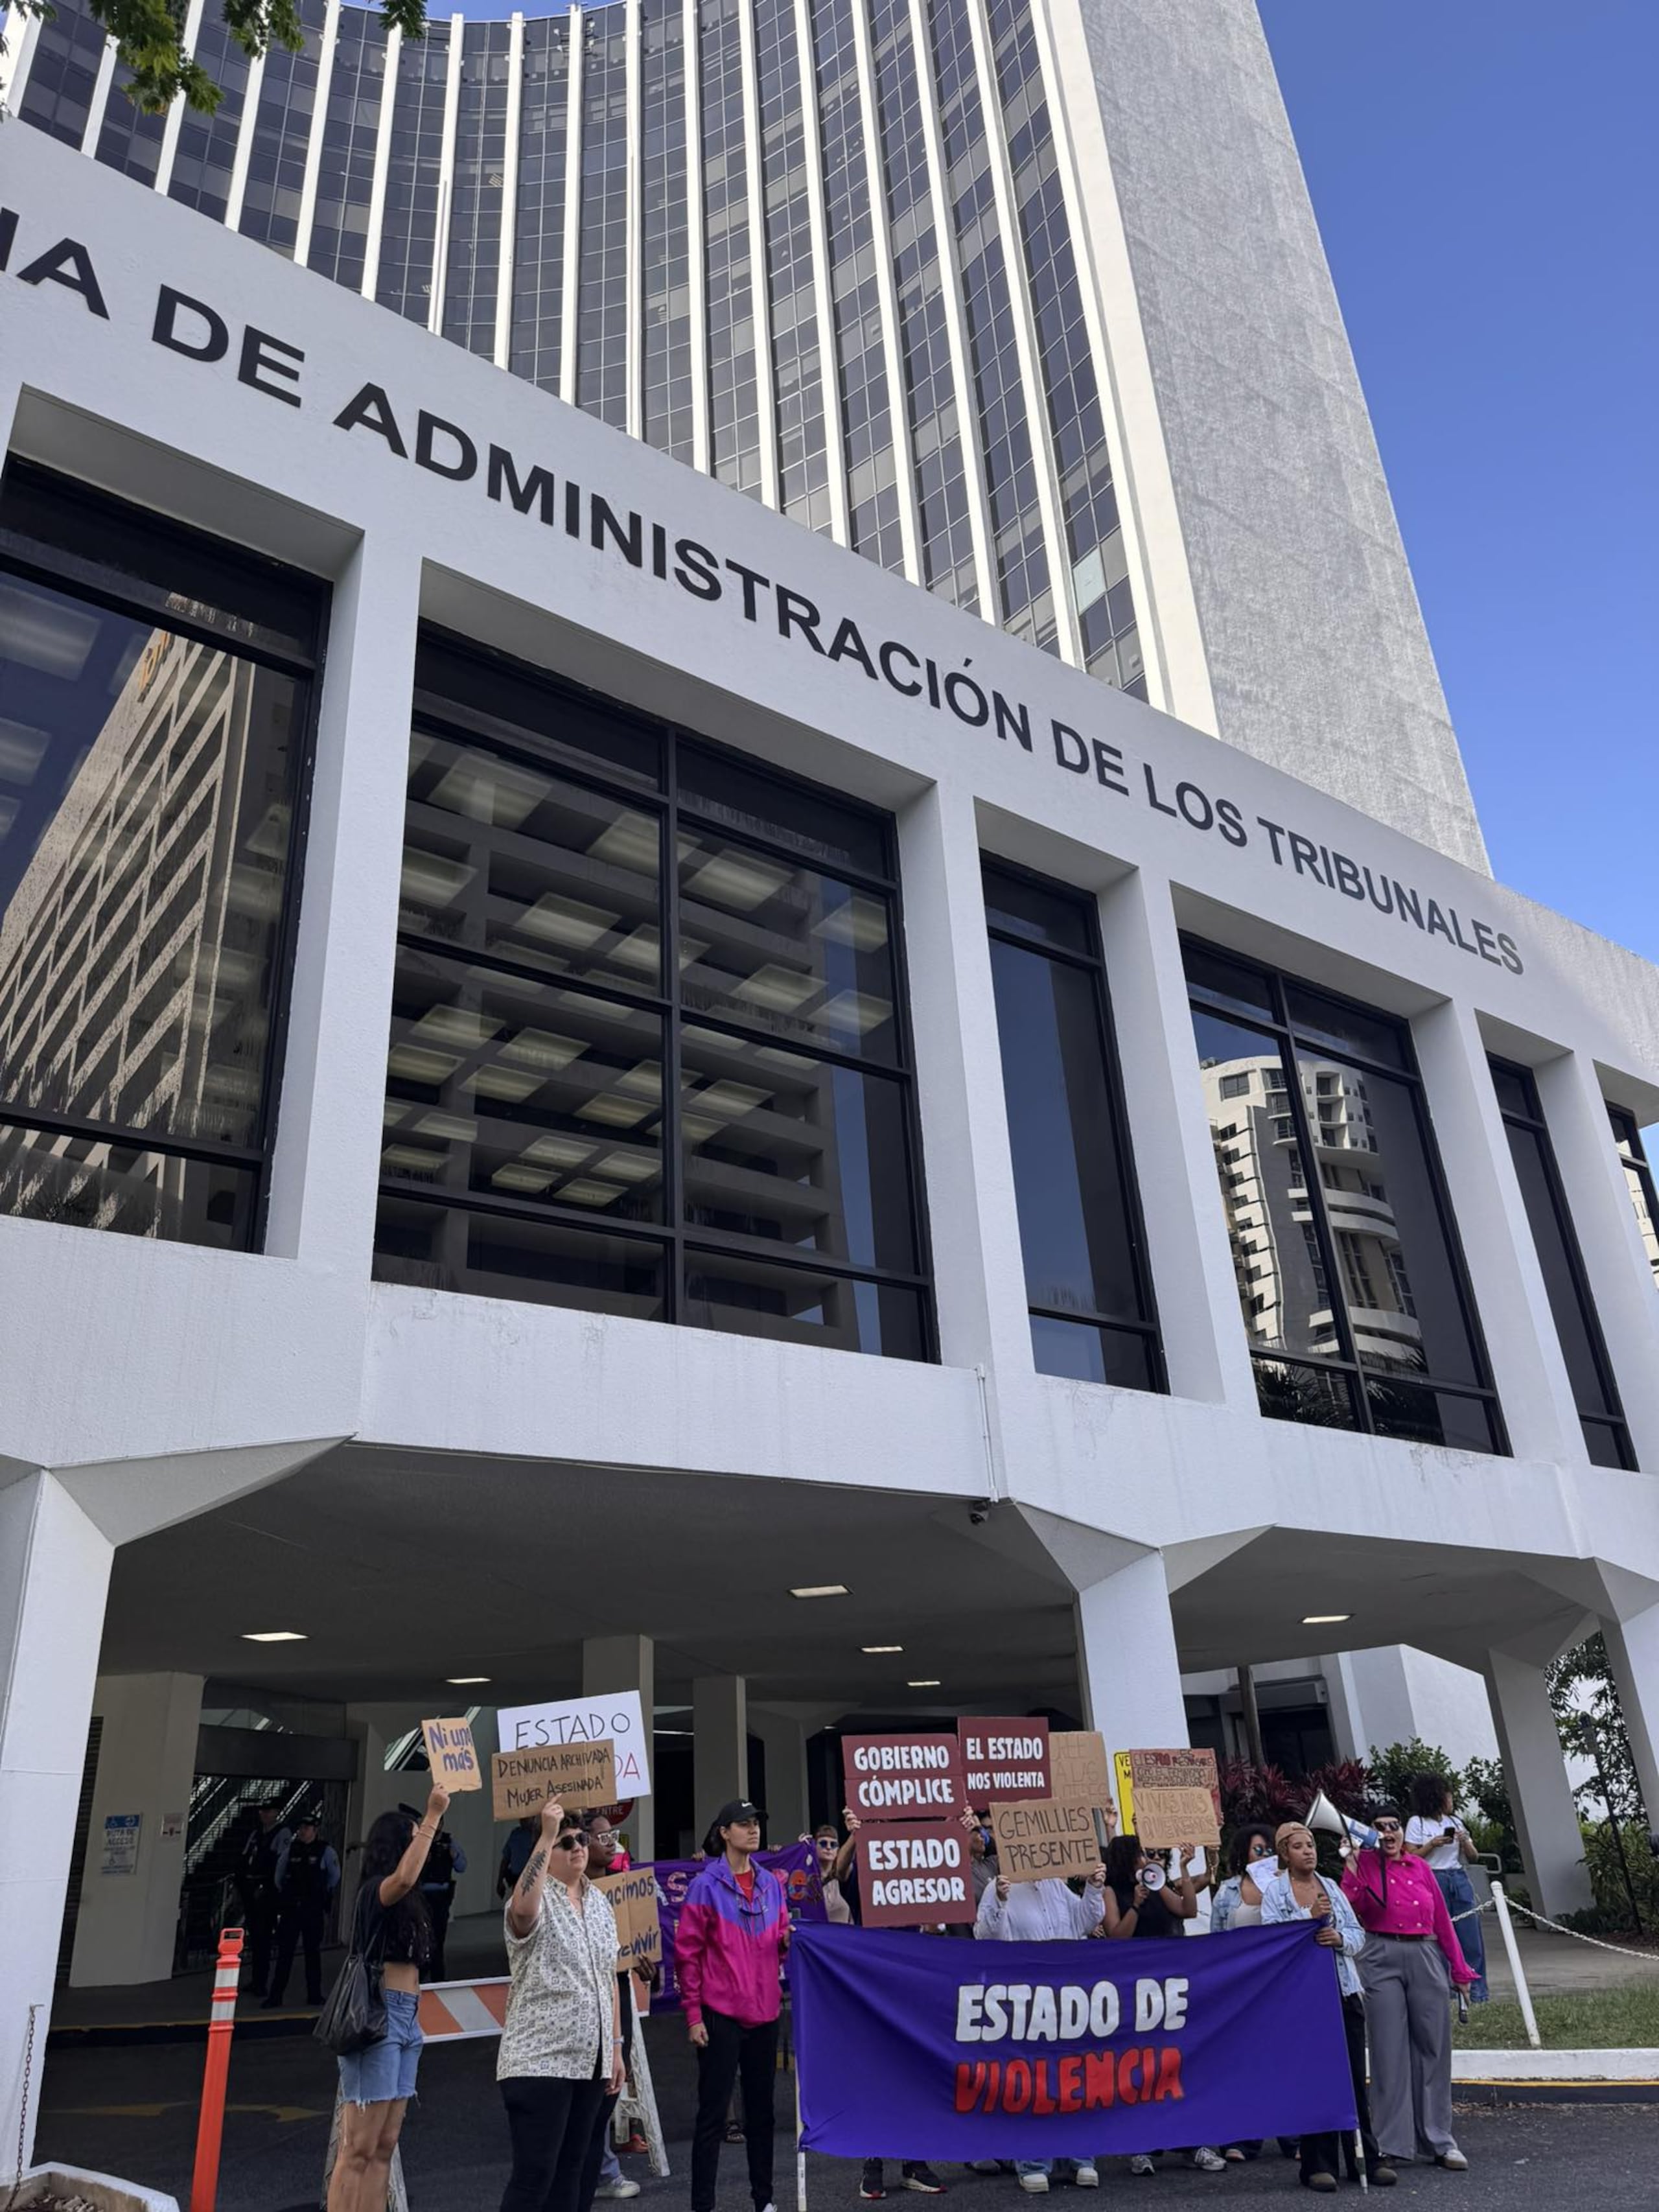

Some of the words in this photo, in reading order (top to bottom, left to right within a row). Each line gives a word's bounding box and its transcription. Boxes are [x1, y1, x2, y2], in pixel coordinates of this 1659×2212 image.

[151, 284, 305, 408] DE
[332, 382, 1034, 752] ADMINISTRACIÓN
[1050, 719, 1129, 797] DE
[1143, 763, 1247, 848] LOS
[1257, 817, 1524, 975] TRIBUNALES
[428, 1722, 448, 1753] Ni
[516, 1713, 631, 1750] ESTADO
[443, 1747, 474, 1771] más
[498, 1756, 557, 1778] DENUNCIA
[560, 1747, 611, 1771] ARCHIVADA
[853, 1745, 950, 1771] GOBIERNO
[966, 1738, 985, 1760] EL
[988, 1738, 1043, 1760] ESTADO
[858, 1775, 955, 1807] CÓMPLICE
[967, 1773, 991, 1789] NOS
[993, 1772, 1045, 1789] VIOLENTA
[868, 1838, 961, 1870] ESTADO
[1005, 1839, 1096, 1872] PRESENTE
[872, 1876, 966, 1906] AGRESOR
[955, 1980, 1120, 2042] ESTADO
[1135, 1977, 1189, 2032] DE
[954, 2047, 1185, 2115] VIOLENCIA
